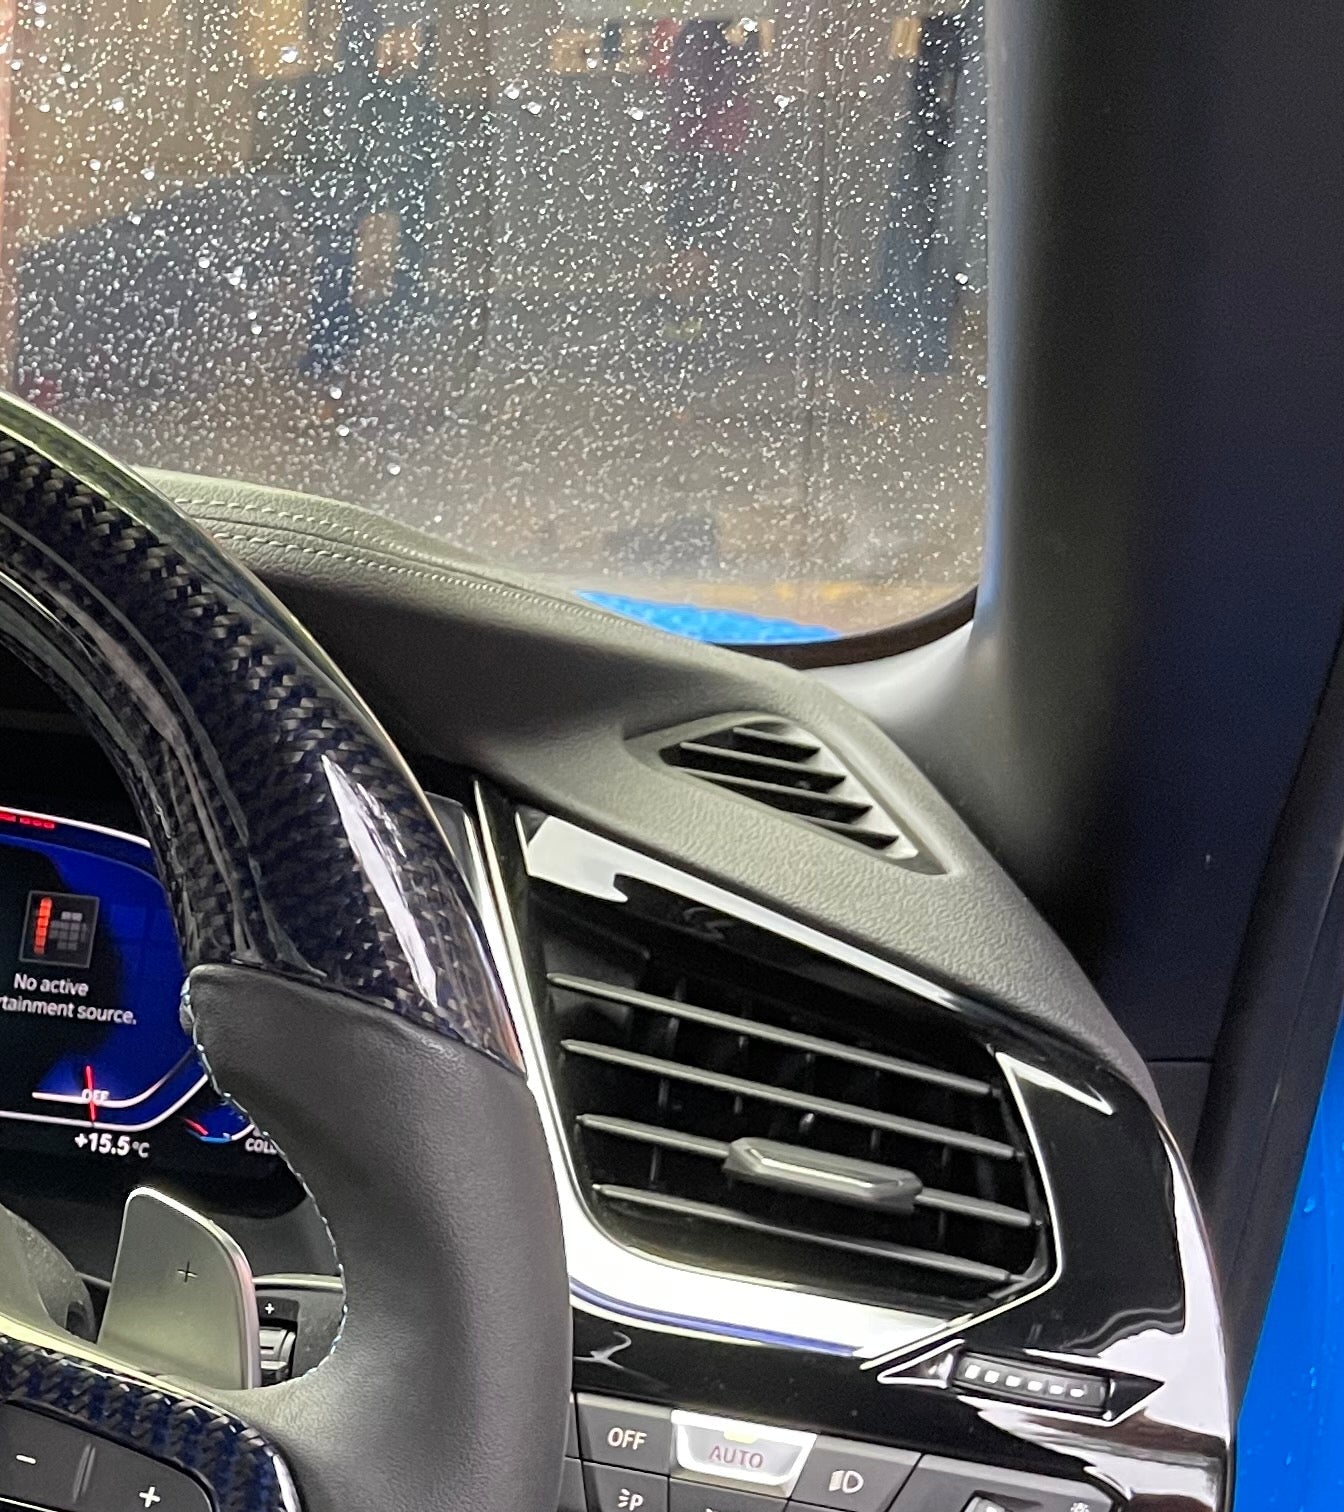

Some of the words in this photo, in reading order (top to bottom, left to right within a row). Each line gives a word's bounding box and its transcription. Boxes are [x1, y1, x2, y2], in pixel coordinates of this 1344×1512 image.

[14, 973, 38, 991] No
[40, 976, 90, 997] active
[77, 1004, 137, 1025] source.
[607, 1427, 648, 1451] OFF
[708, 1444, 764, 1469] AUTO
